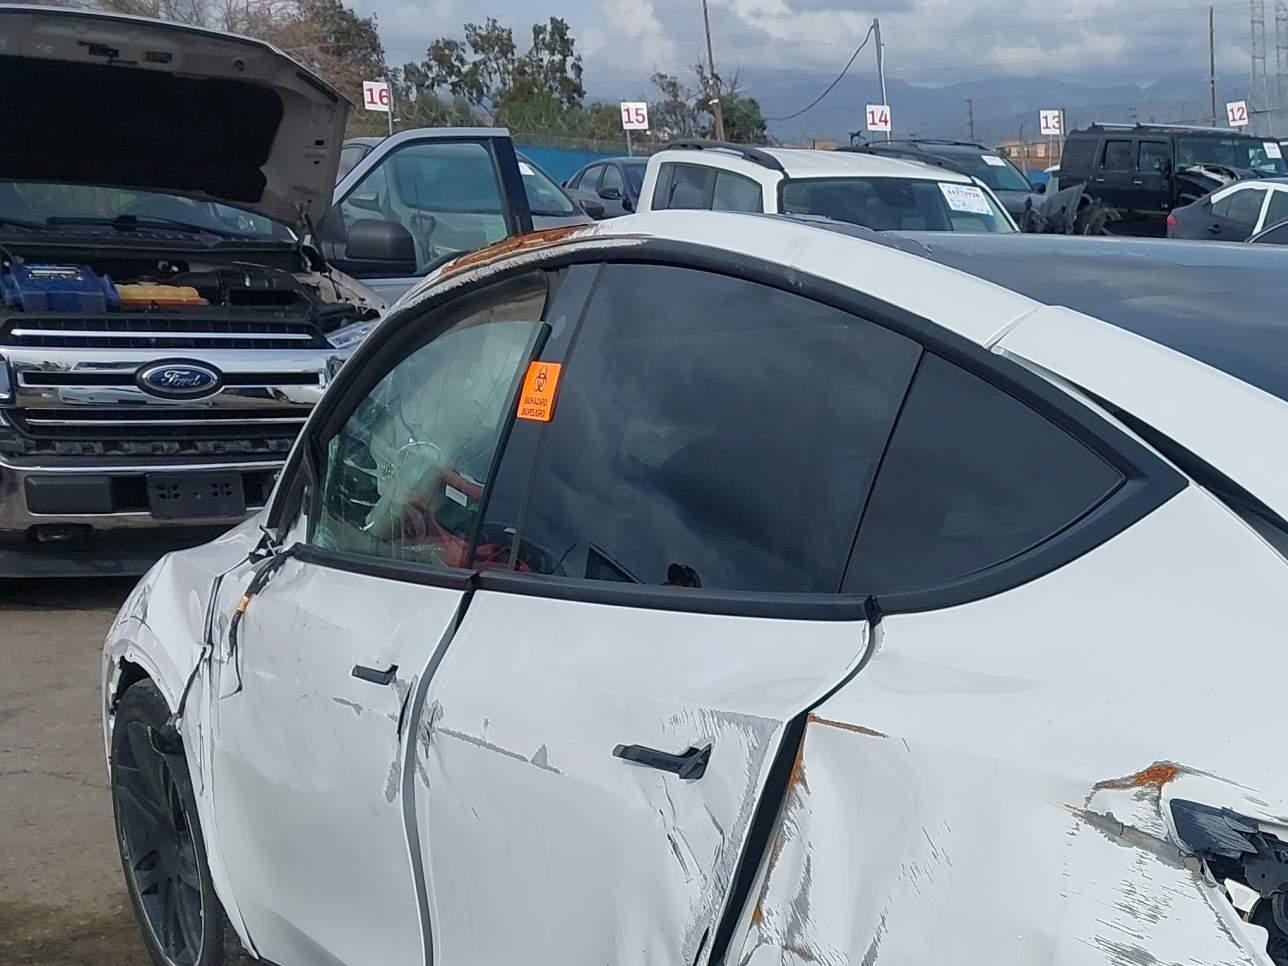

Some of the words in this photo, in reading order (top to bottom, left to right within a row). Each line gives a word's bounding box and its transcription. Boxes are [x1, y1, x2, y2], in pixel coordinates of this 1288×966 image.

[366, 88, 389, 106] 16
[623, 107, 646, 124] 15
[868, 110, 888, 126] 14
[1229, 106, 1246, 122] 12
[1042, 115, 1060, 130] 13
[160, 369, 201, 387] Ford
